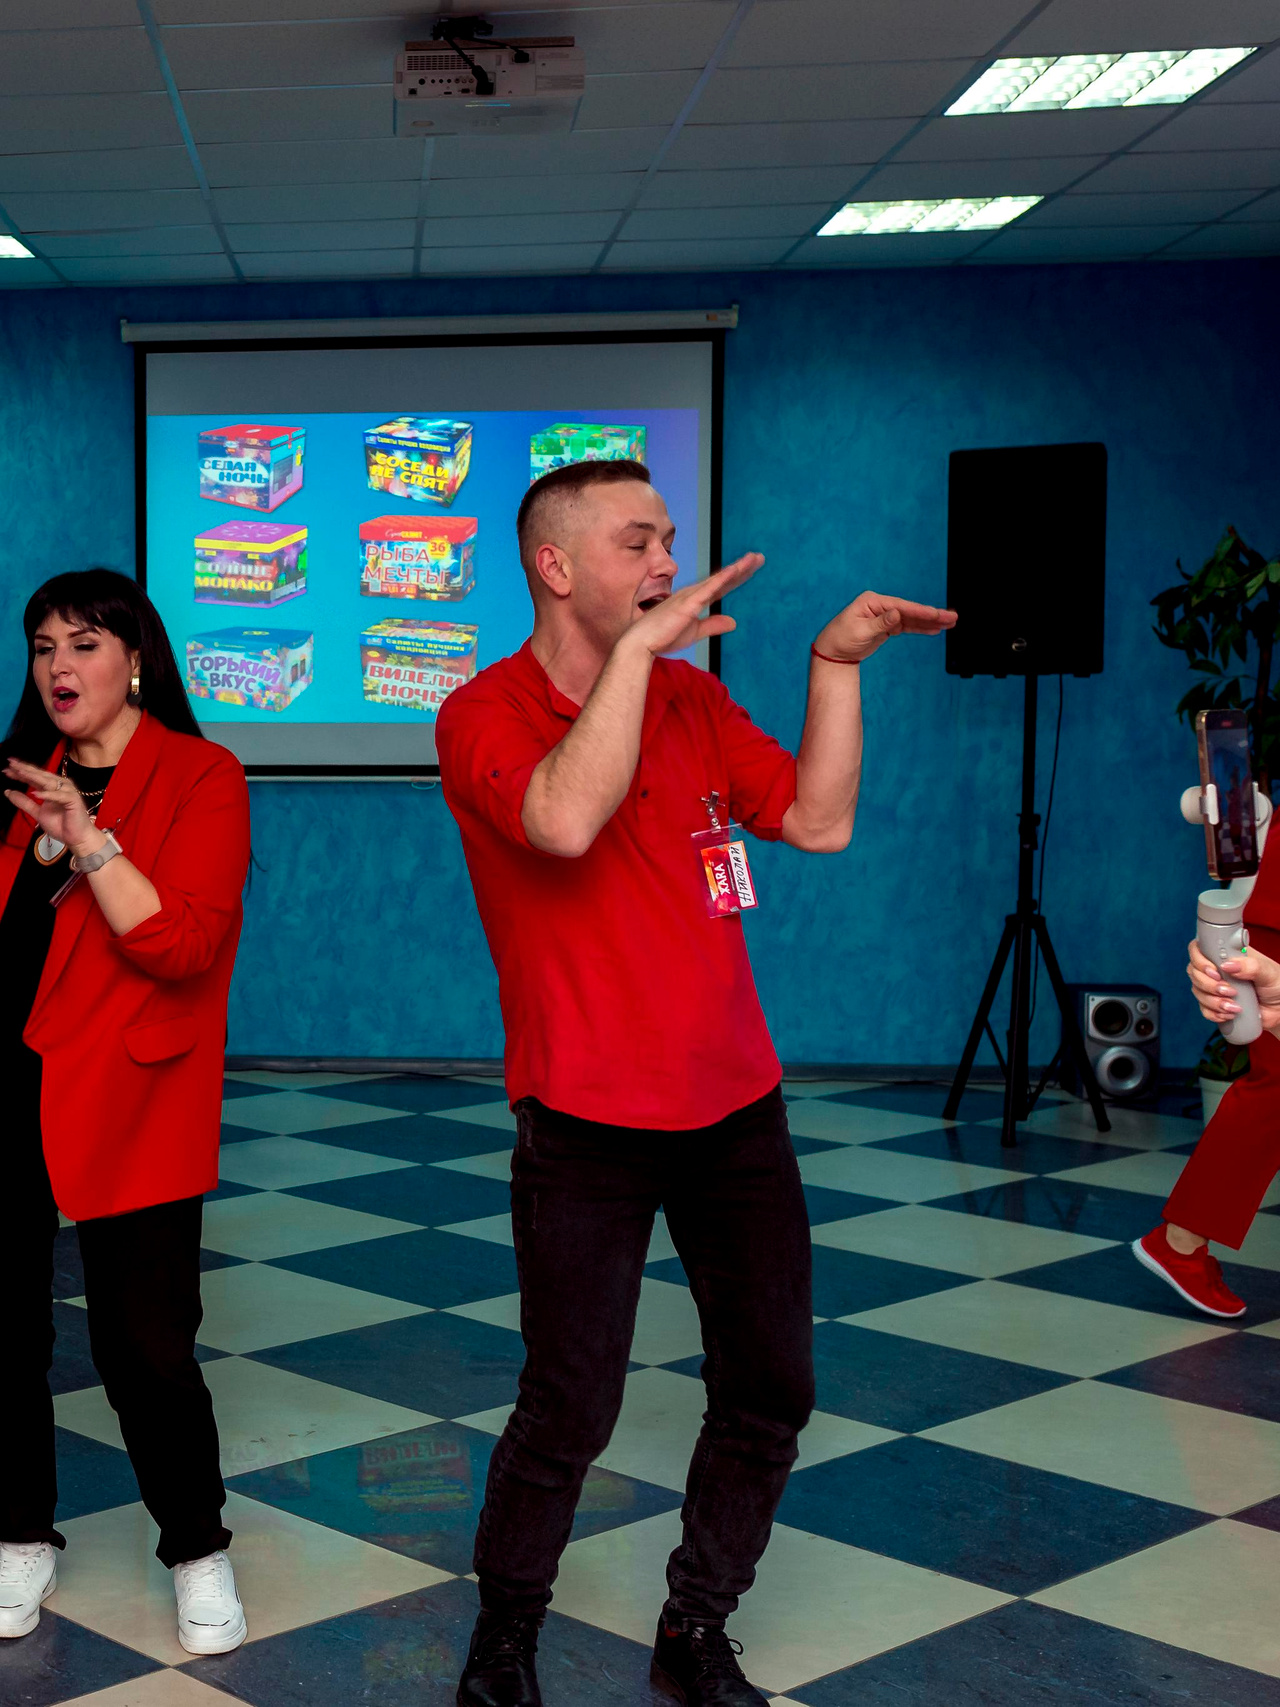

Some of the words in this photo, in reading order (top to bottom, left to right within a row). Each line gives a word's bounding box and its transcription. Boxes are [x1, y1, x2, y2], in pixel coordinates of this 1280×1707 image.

[200, 459, 257, 472] СЕДАЯ
[375, 453, 450, 479] СОСЕДИ
[218, 472, 269, 484] НОЧЬ
[370, 465, 395, 479] НЕ
[399, 471, 448, 491] СПЯТ
[365, 544, 430, 564] РЫБА
[429, 541, 447, 553] 36
[364, 565, 446, 585] МЕЧТЫ
[188, 656, 281, 684] ГОРЬКИЙ
[369, 665, 463, 688] ВИДЕЛИ
[209, 672, 257, 693] ВКУС
[381, 683, 445, 704] НОЧЬ
